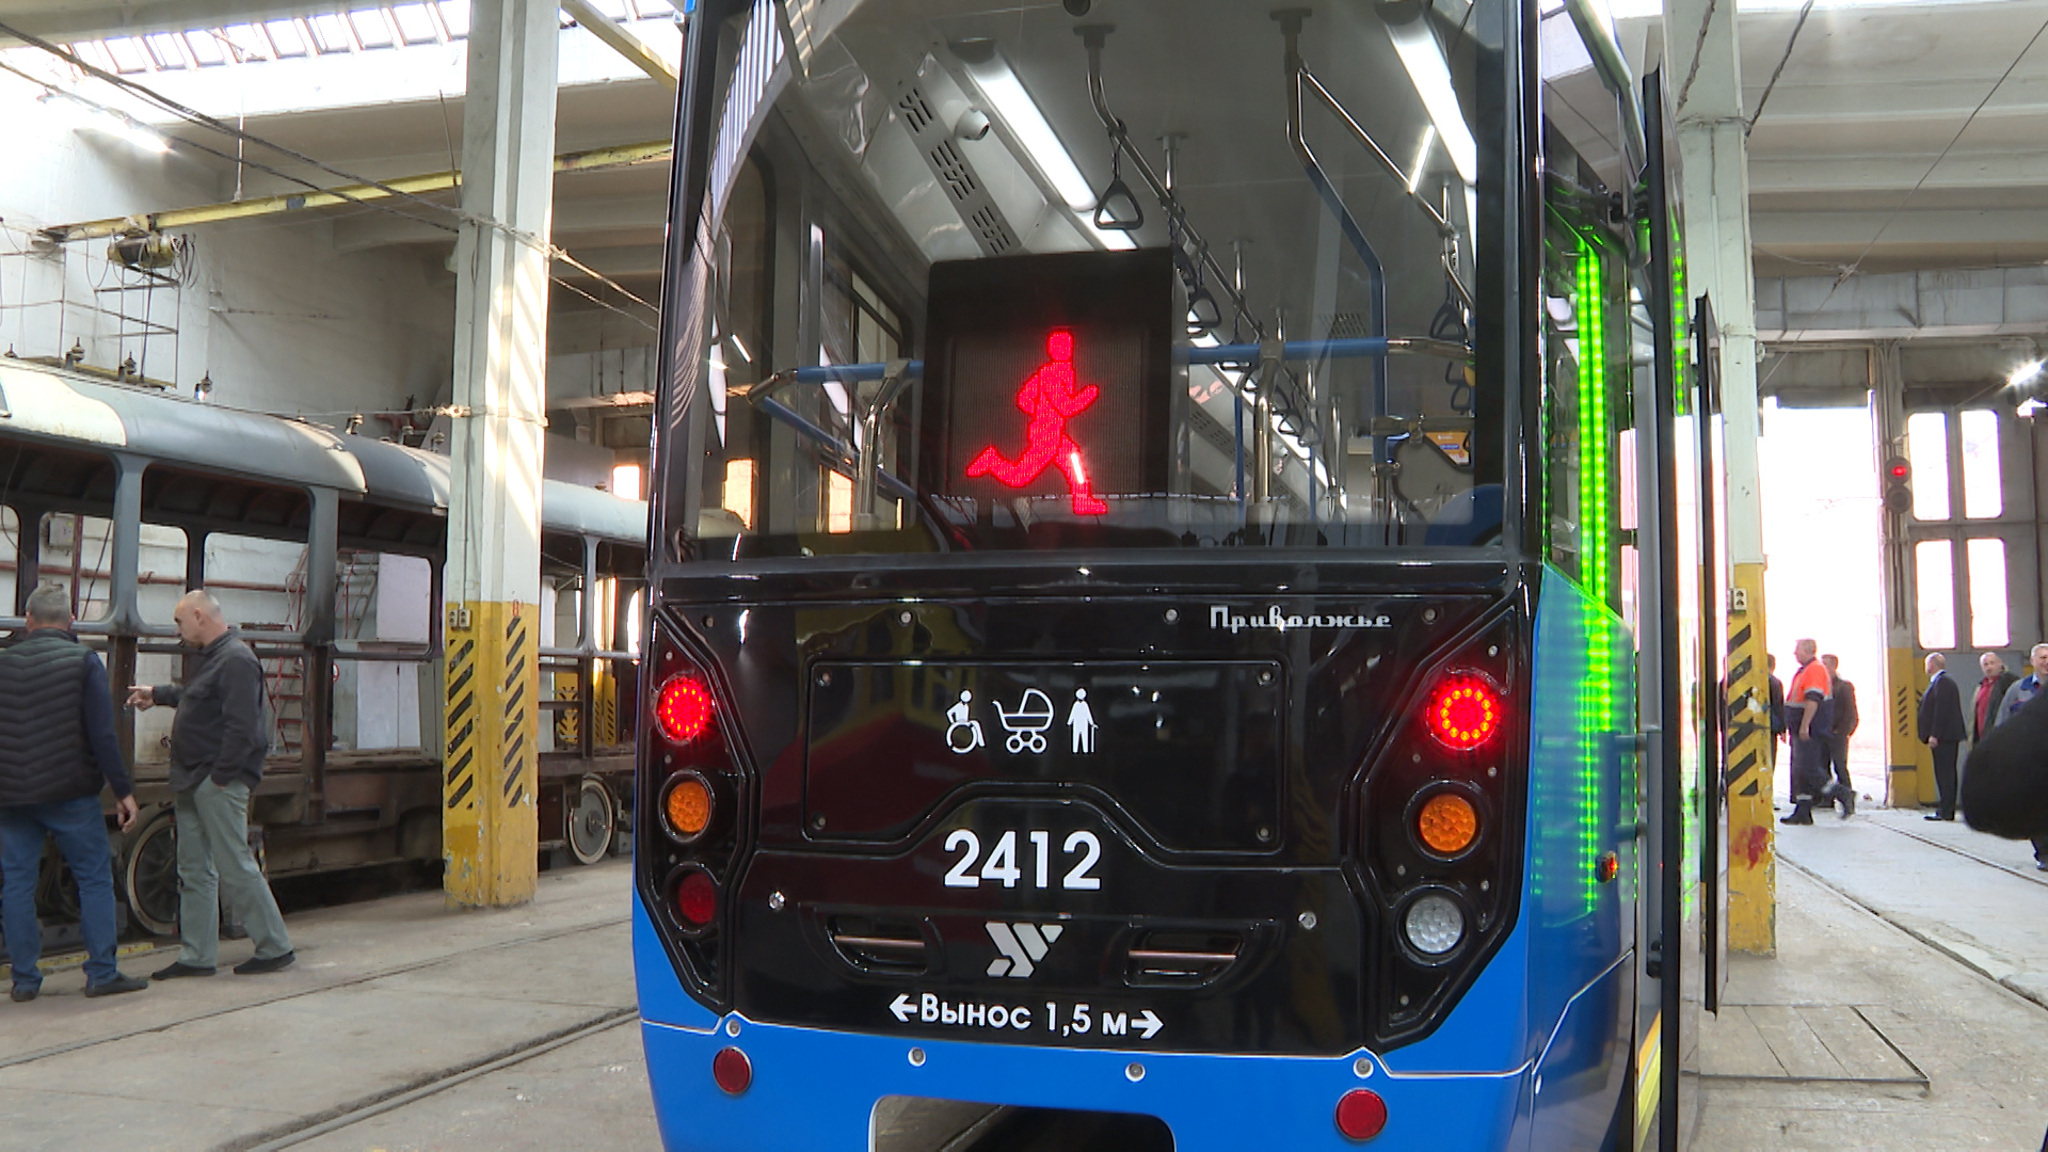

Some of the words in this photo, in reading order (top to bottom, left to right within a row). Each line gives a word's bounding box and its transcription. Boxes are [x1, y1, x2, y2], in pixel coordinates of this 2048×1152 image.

[1210, 605, 1392, 634] Приволжье
[944, 829, 1101, 890] 2412
[921, 992, 1031, 1029] Вынос
[1046, 1001, 1092, 1037] 1,5
[1102, 1011, 1127, 1035] м
